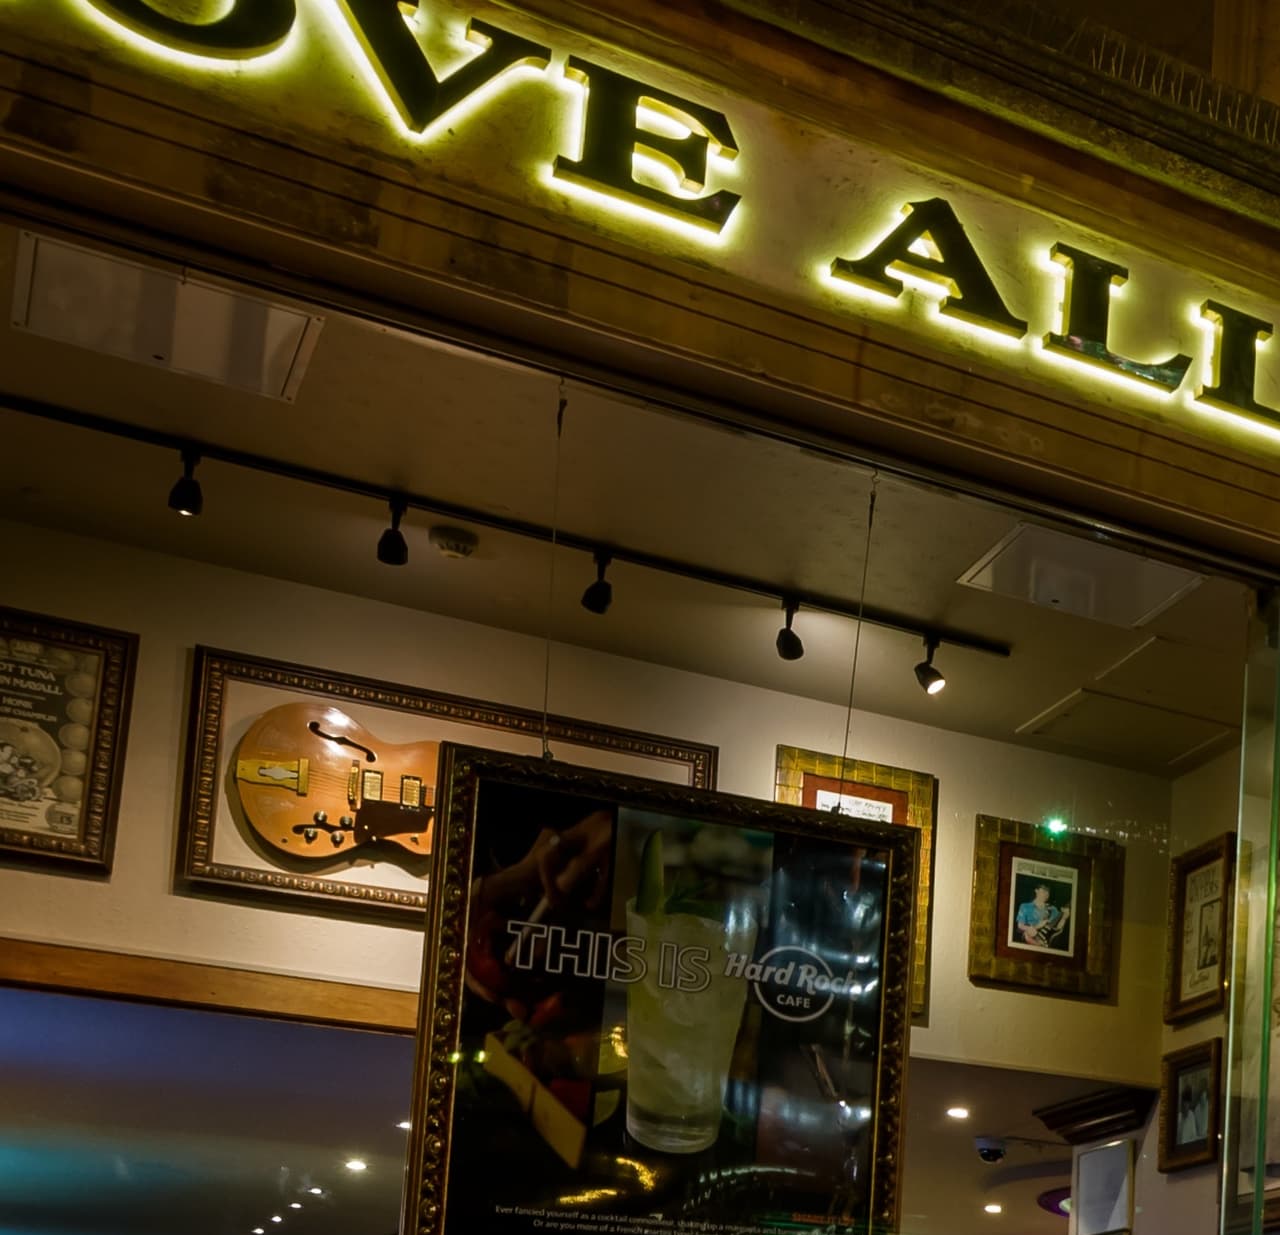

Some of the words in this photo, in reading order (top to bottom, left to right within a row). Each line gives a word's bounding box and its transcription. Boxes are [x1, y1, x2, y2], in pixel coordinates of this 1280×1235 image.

[18, 665, 56, 681] TUNA
[13, 677, 64, 695] MAYALL
[507, 920, 647, 984] THIS
[658, 942, 713, 992] IS
[723, 952, 791, 986] Hard
[775, 992, 812, 1010] CAFE
